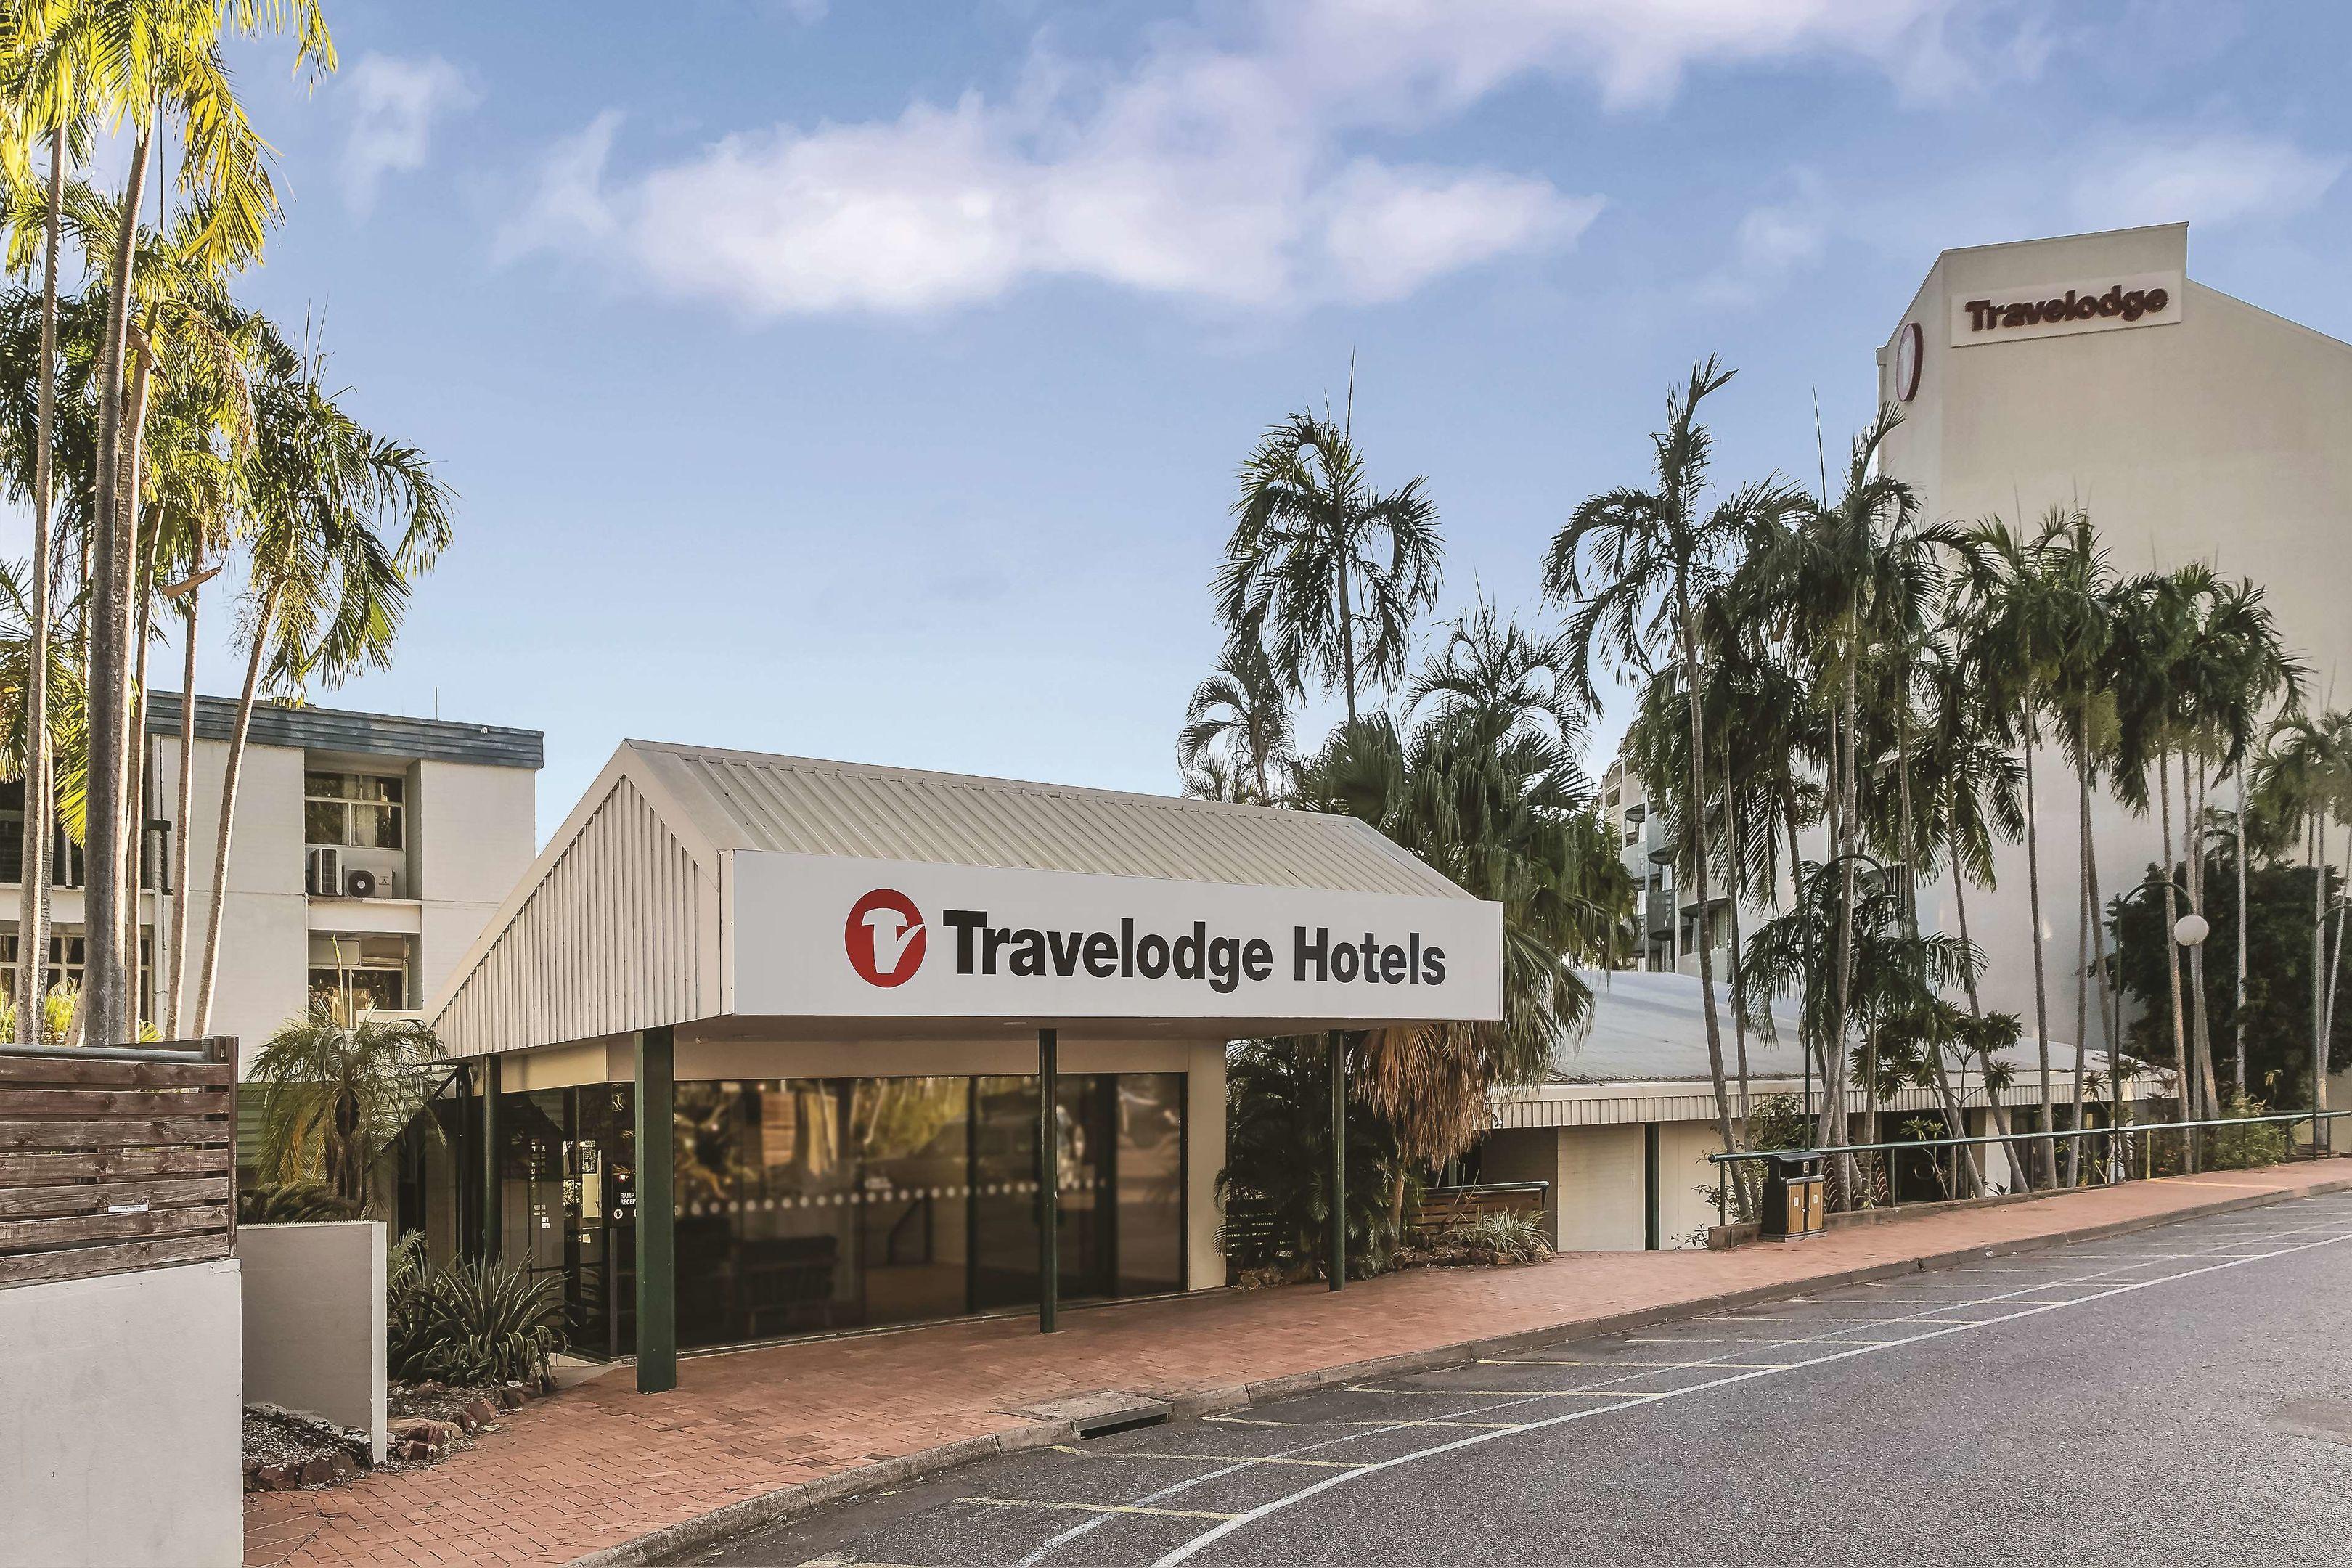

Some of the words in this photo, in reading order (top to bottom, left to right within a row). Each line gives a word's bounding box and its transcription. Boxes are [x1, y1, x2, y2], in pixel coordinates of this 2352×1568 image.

[1964, 284, 2169, 332] Travelodge
[943, 909, 1273, 994] Travelodge
[1294, 926, 1446, 986] Hotels
